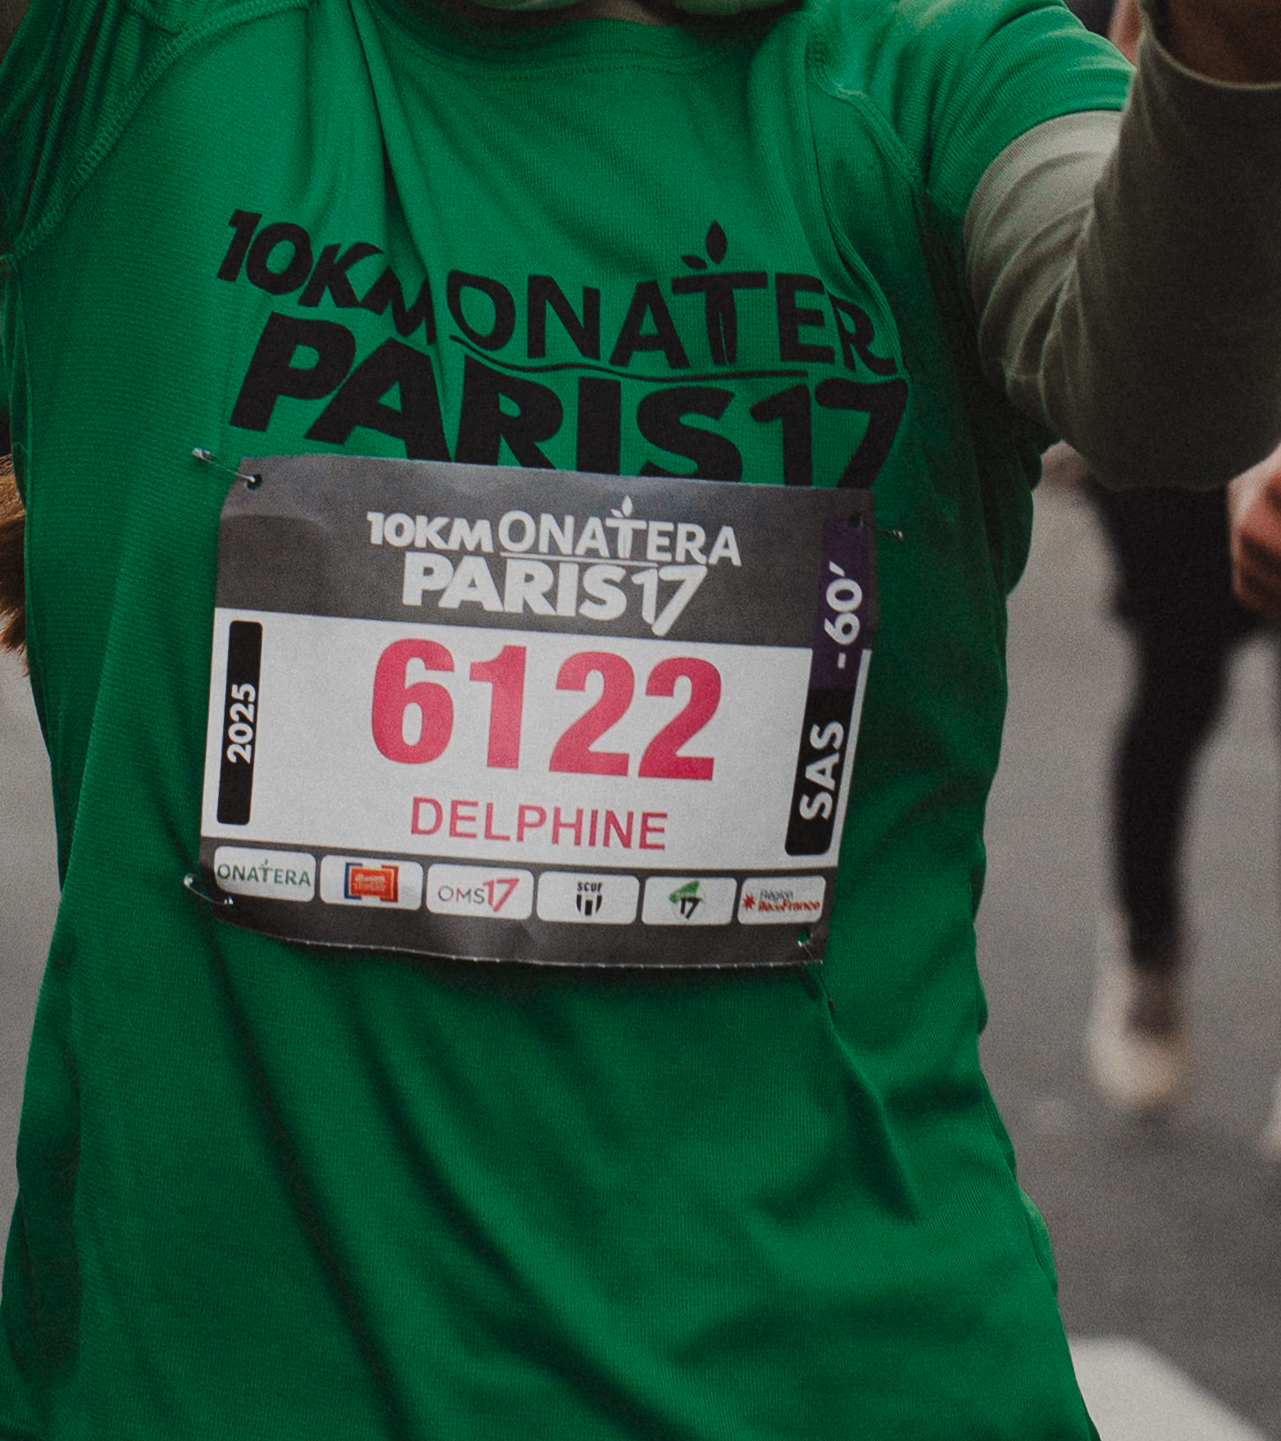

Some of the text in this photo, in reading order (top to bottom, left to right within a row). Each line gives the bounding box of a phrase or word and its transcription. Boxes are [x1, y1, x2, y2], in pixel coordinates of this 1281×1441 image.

[216, 208, 437, 346] 10KM
[366, 509, 743, 568] 10KM ONATERA
[226, 681, 257, 765] 2025
[371, 637, 723, 782] 6122
[798, 720, 845, 822] SAS
[409, 795, 669, 852] DELPHINE
[216, 863, 312, 888] ONATERA
